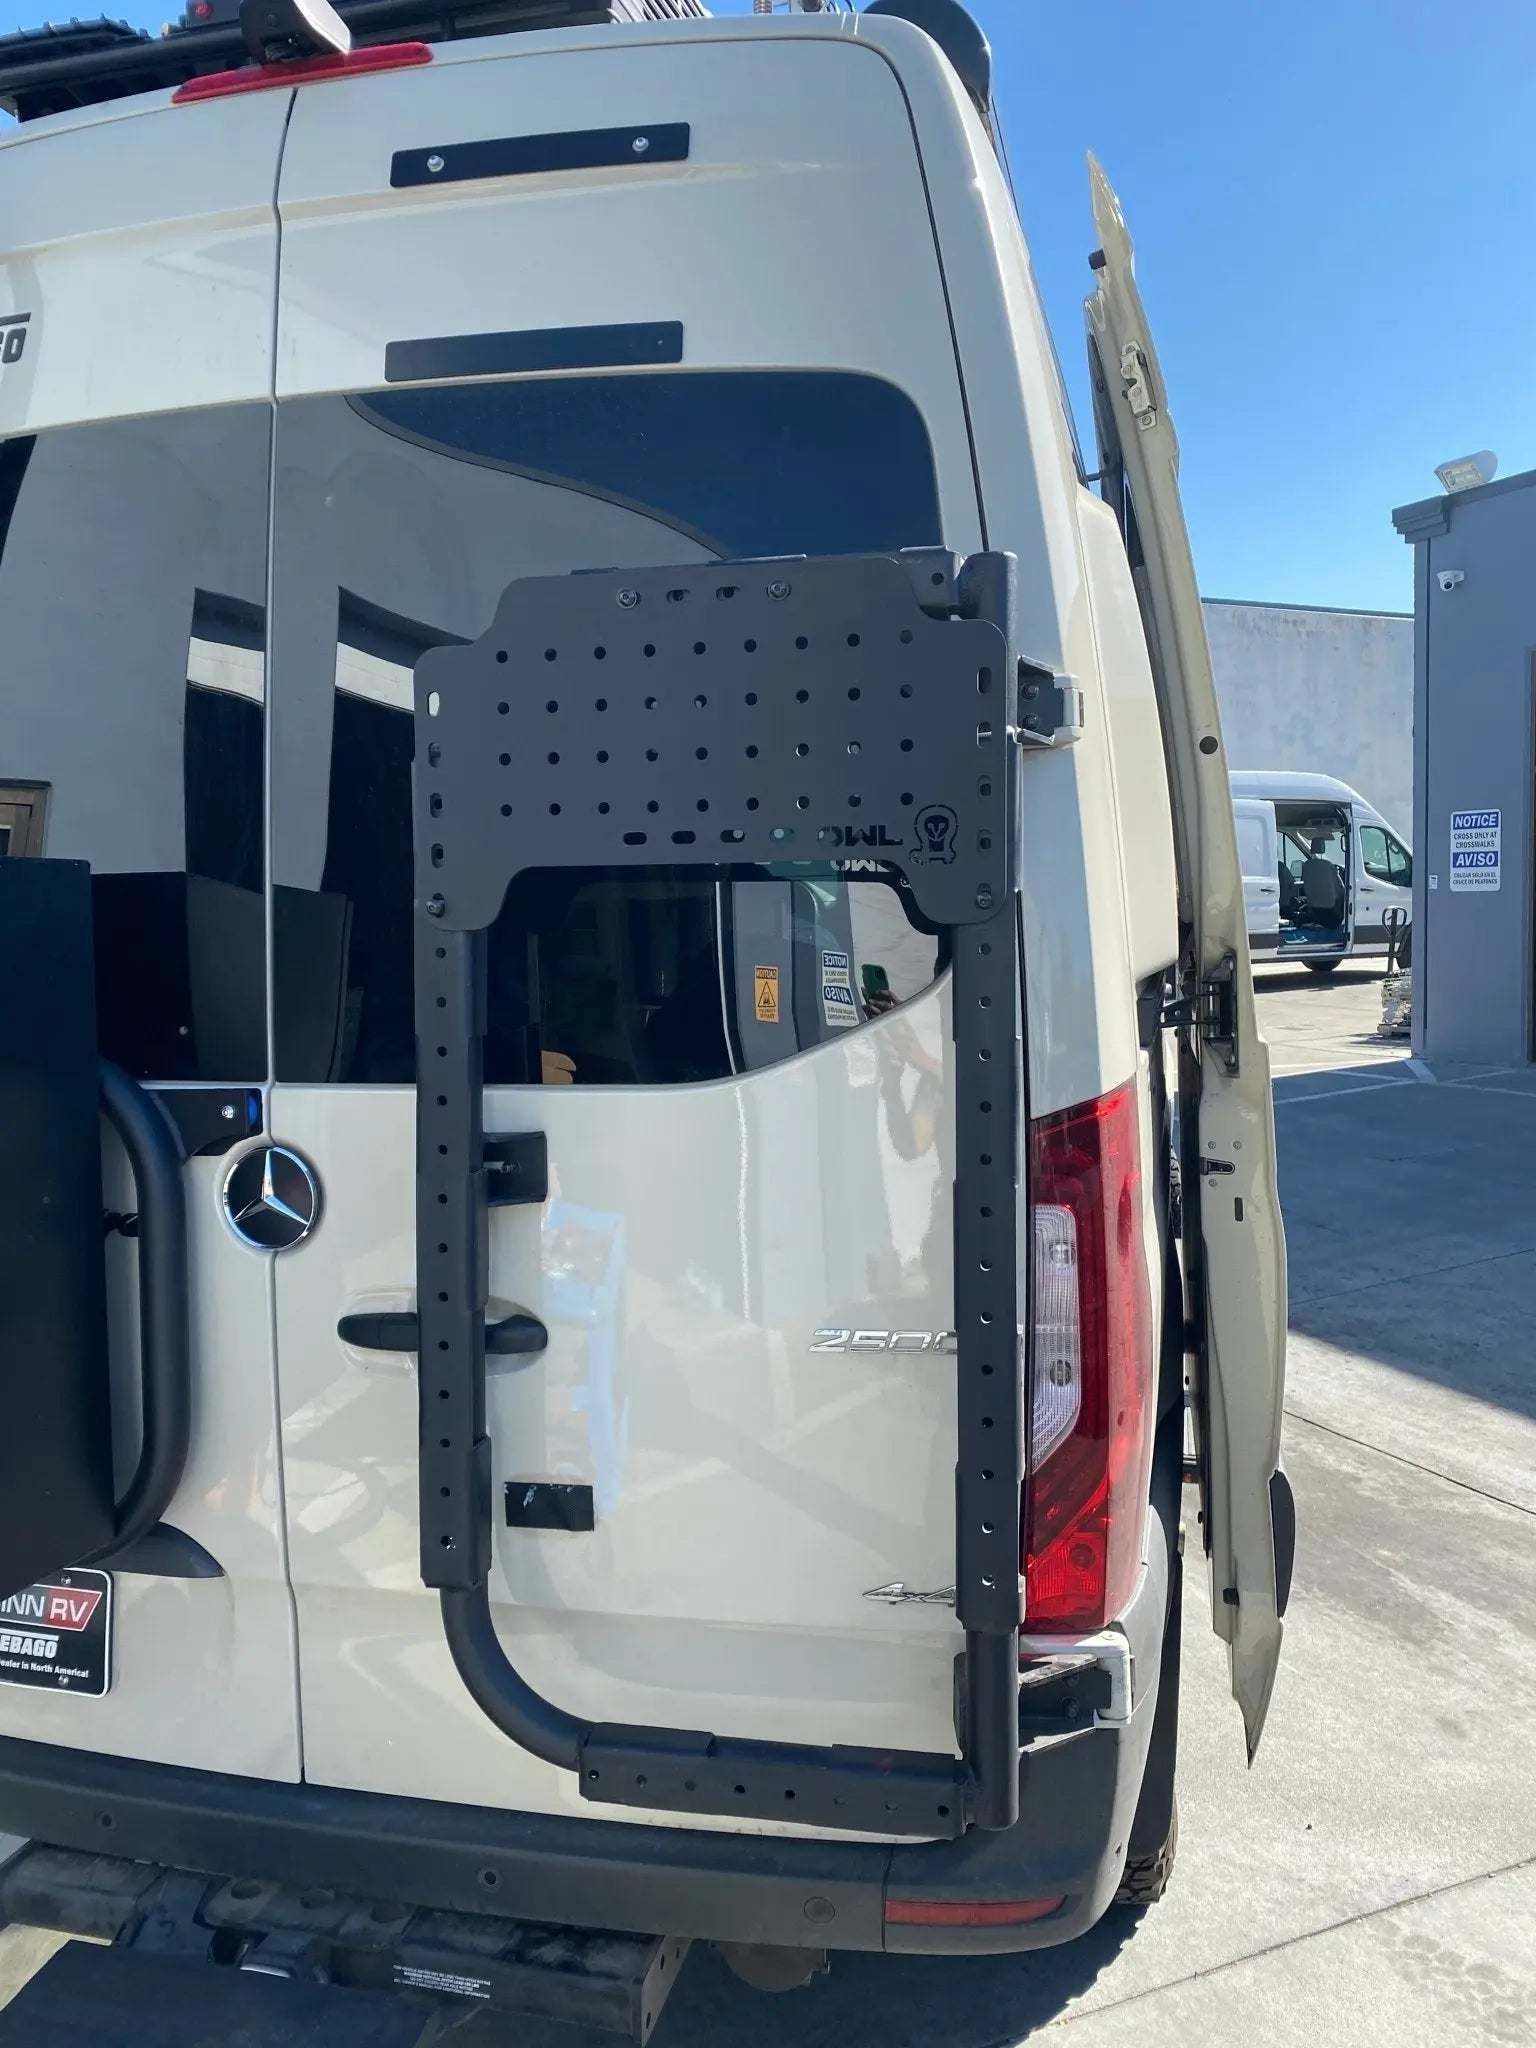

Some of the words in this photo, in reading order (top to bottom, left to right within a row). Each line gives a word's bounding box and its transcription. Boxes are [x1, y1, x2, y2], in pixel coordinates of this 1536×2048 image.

[1454, 814, 1497, 828] NOTICE
[817, 825, 903, 847] OWL
[1453, 832, 1473, 840] CROSS
[1474, 831, 1489, 839] ONLY
[1455, 852, 1496, 867] AVISO
[49, 1597, 88, 1622] RV
[21, 1660, 30, 1670] in
[30, 1662, 53, 1673] North
